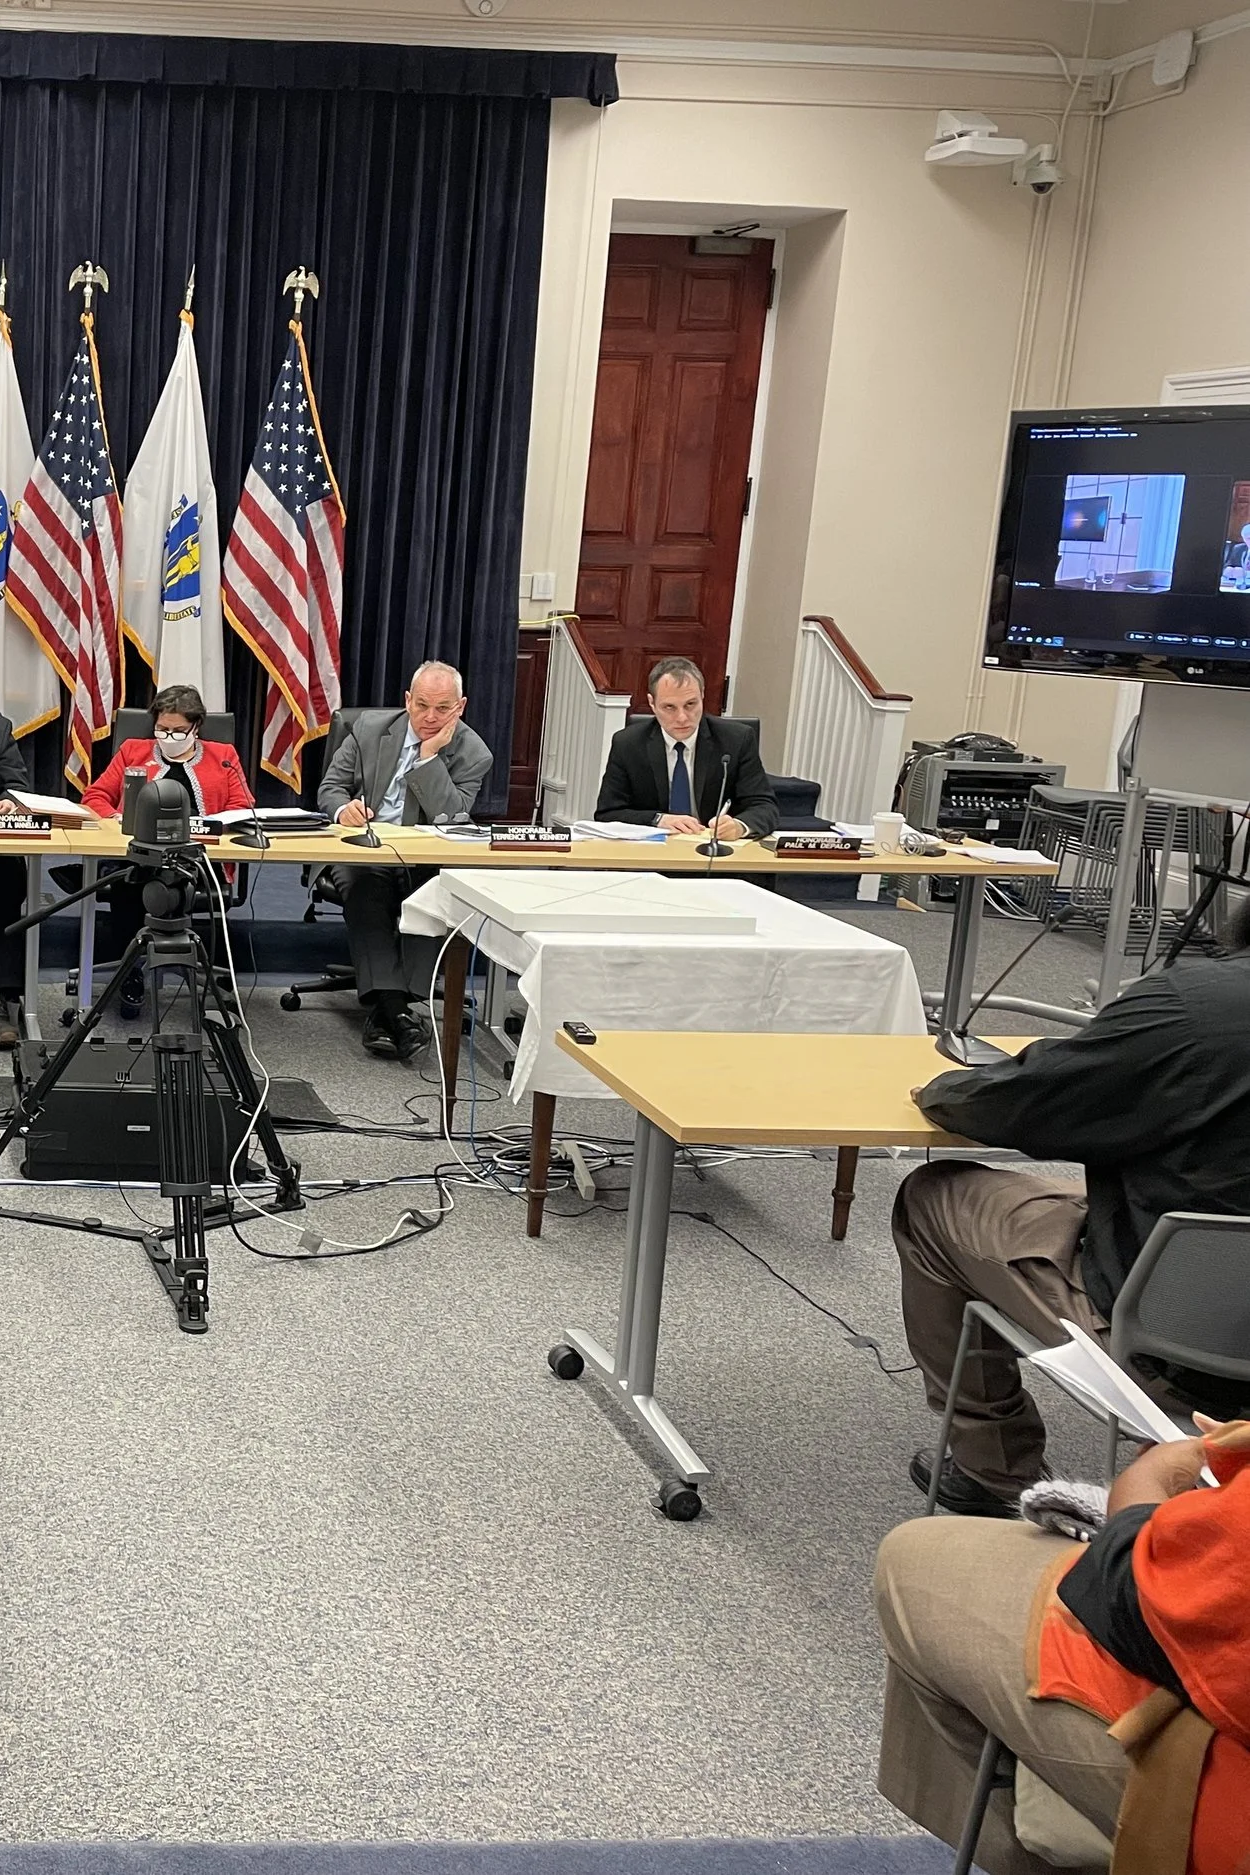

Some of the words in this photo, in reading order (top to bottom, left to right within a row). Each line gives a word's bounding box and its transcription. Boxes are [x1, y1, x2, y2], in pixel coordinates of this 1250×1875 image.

[492, 833, 526, 841] TERRENCE
[538, 833, 570, 841] KENNEDY
[819, 842, 851, 850] DEPALO
